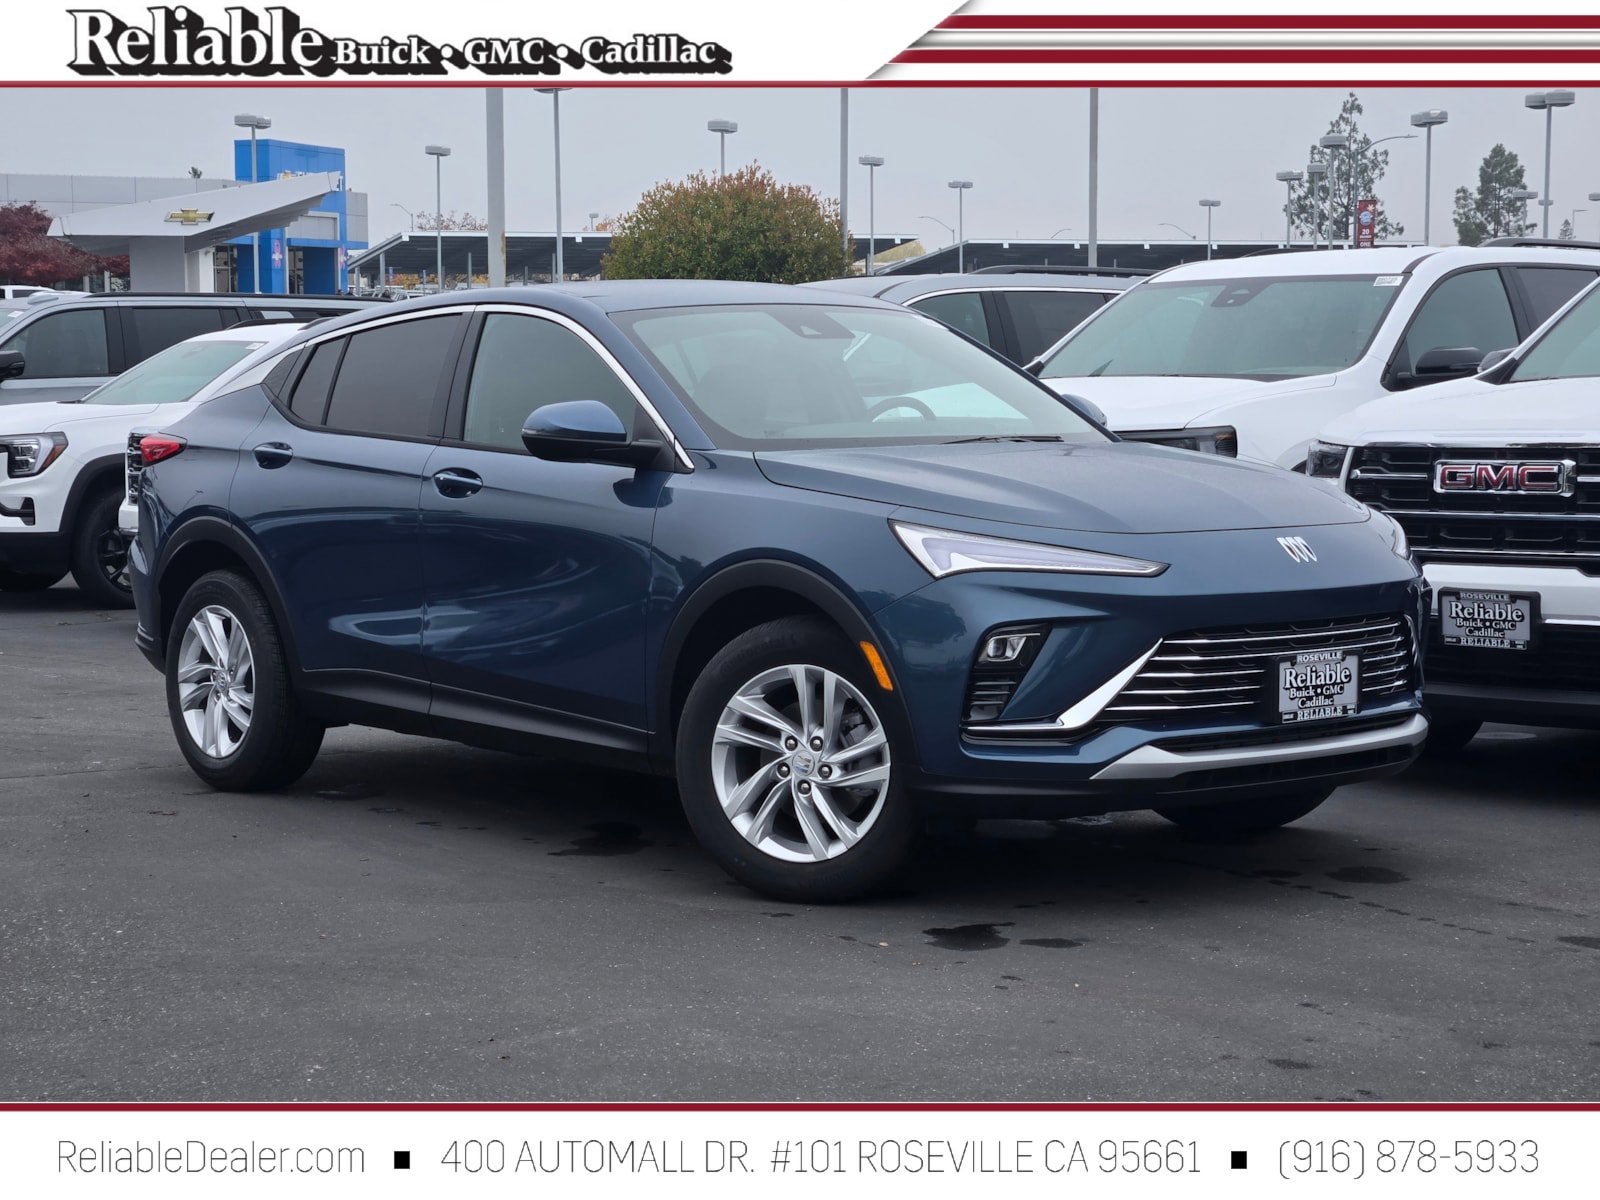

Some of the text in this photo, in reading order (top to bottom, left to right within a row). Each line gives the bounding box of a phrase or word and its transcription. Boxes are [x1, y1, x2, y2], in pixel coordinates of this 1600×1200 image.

[1440, 464, 1559, 490] GMC
[1460, 592, 1510, 601] ROSEVILLE
[1449, 601, 1524, 622] Reliable
[1456, 618, 1516, 630] Buick GMC
[1465, 627, 1505, 638] Cadillac
[1460, 637, 1511, 648] RELIABLE
[1297, 651, 1343, 662] ROSEVILLE
[1284, 662, 1352, 689] Reliable
[1289, 684, 1345, 699] Buick GMC
[1298, 696, 1334, 709] Cadillac
[1297, 706, 1343, 720] RELIABLE
